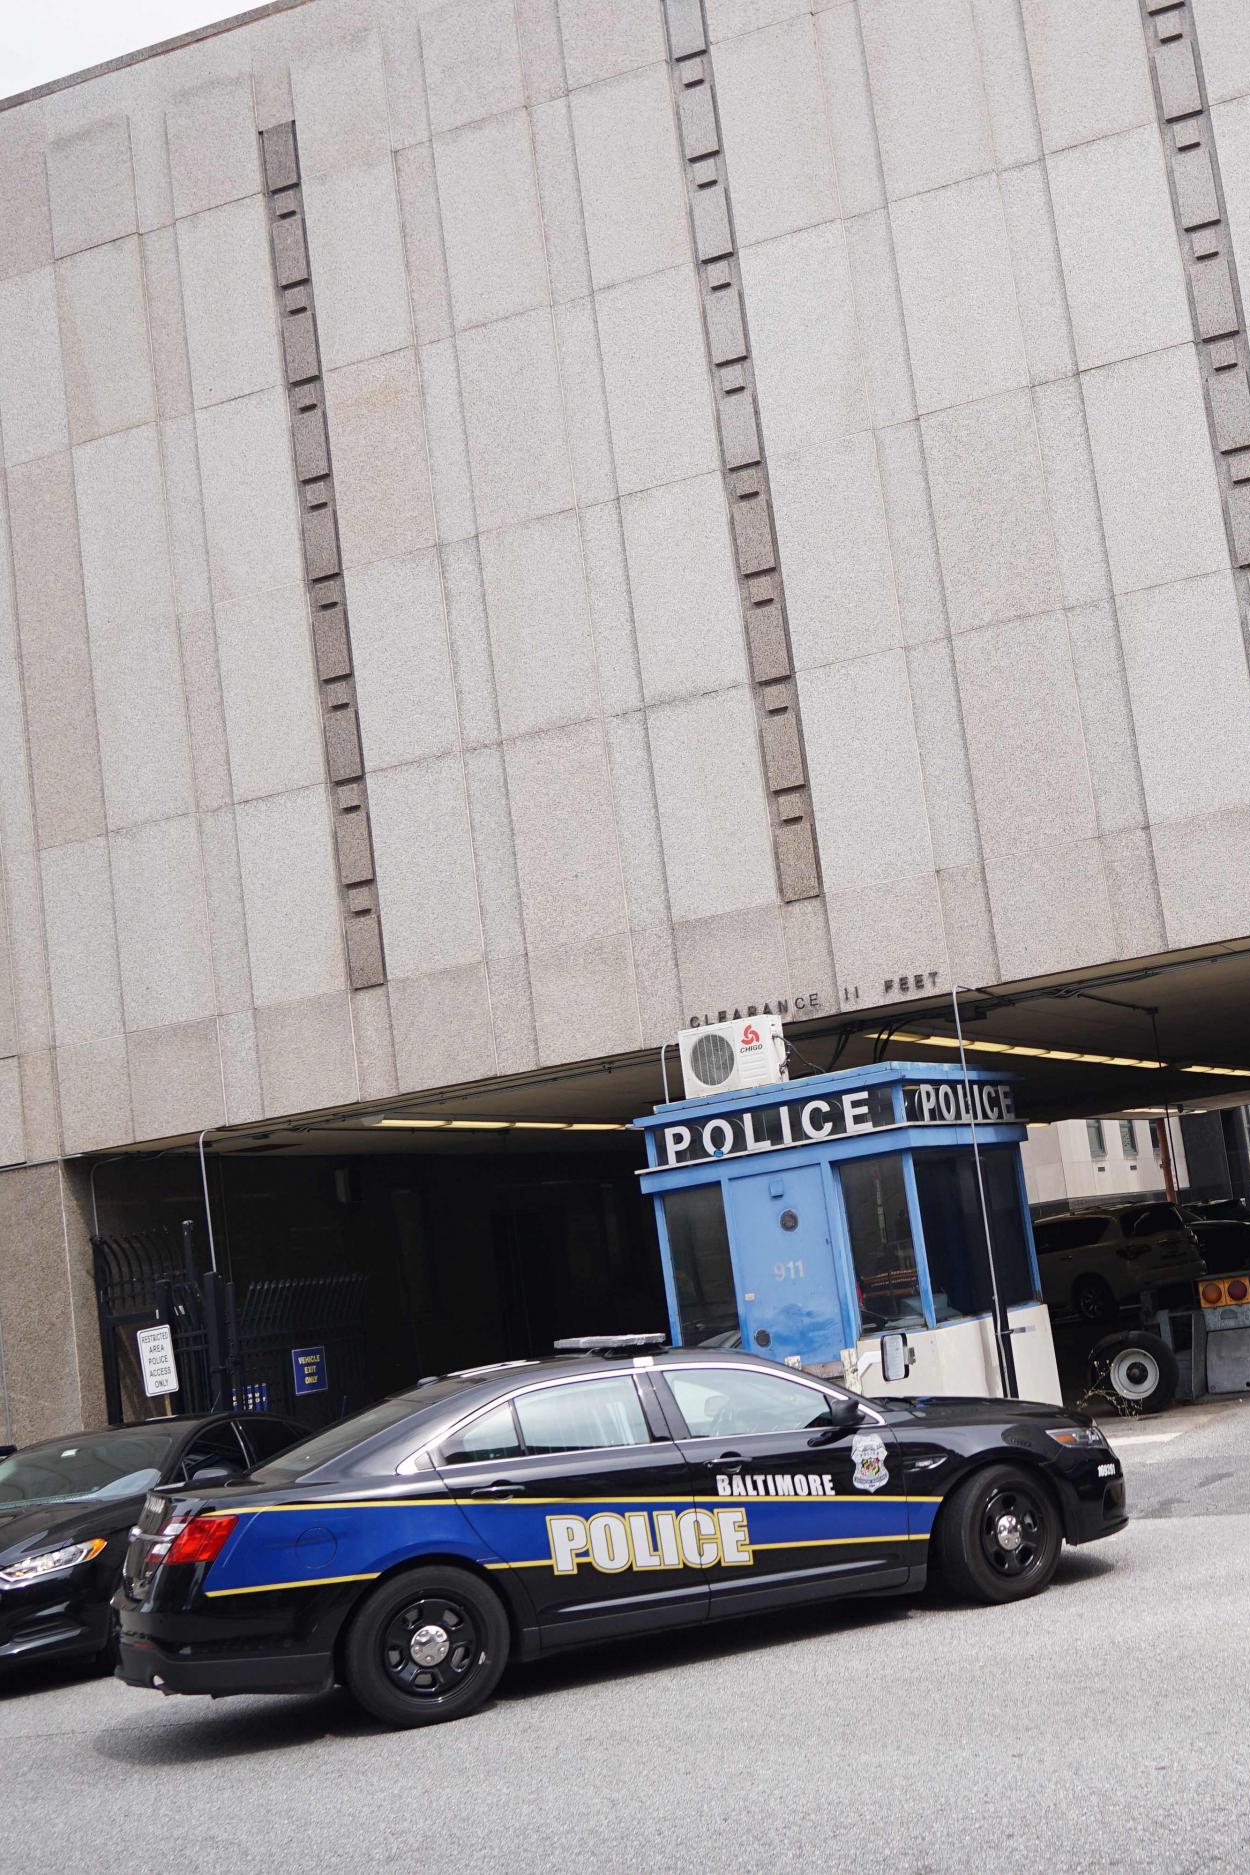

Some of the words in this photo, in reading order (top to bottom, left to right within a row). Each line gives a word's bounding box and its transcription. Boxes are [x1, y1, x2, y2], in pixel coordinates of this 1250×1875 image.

[689, 992, 820, 1028] CLEARANCE
[884, 970, 939, 994] FEET
[739, 1043, 764, 1054] CHIGO
[919, 1083, 1016, 1122] POLICE
[663, 1090, 874, 1166] POLICE
[773, 1259, 805, 1281] 911
[141, 1331, 169, 1344] RESTRICTED
[149, 1344, 165, 1354] AREA
[148, 1354, 169, 1366] POLICE
[297, 1354, 321, 1365] VEHICLE
[149, 1366, 172, 1378] ACCESS
[304, 1365, 317, 1374] EXIT
[154, 1379, 169, 1389] ONLY
[304, 1375, 319, 1385] ONLY
[715, 1474, 836, 1497] BALTIMORE
[545, 1507, 754, 1576] POLICE
